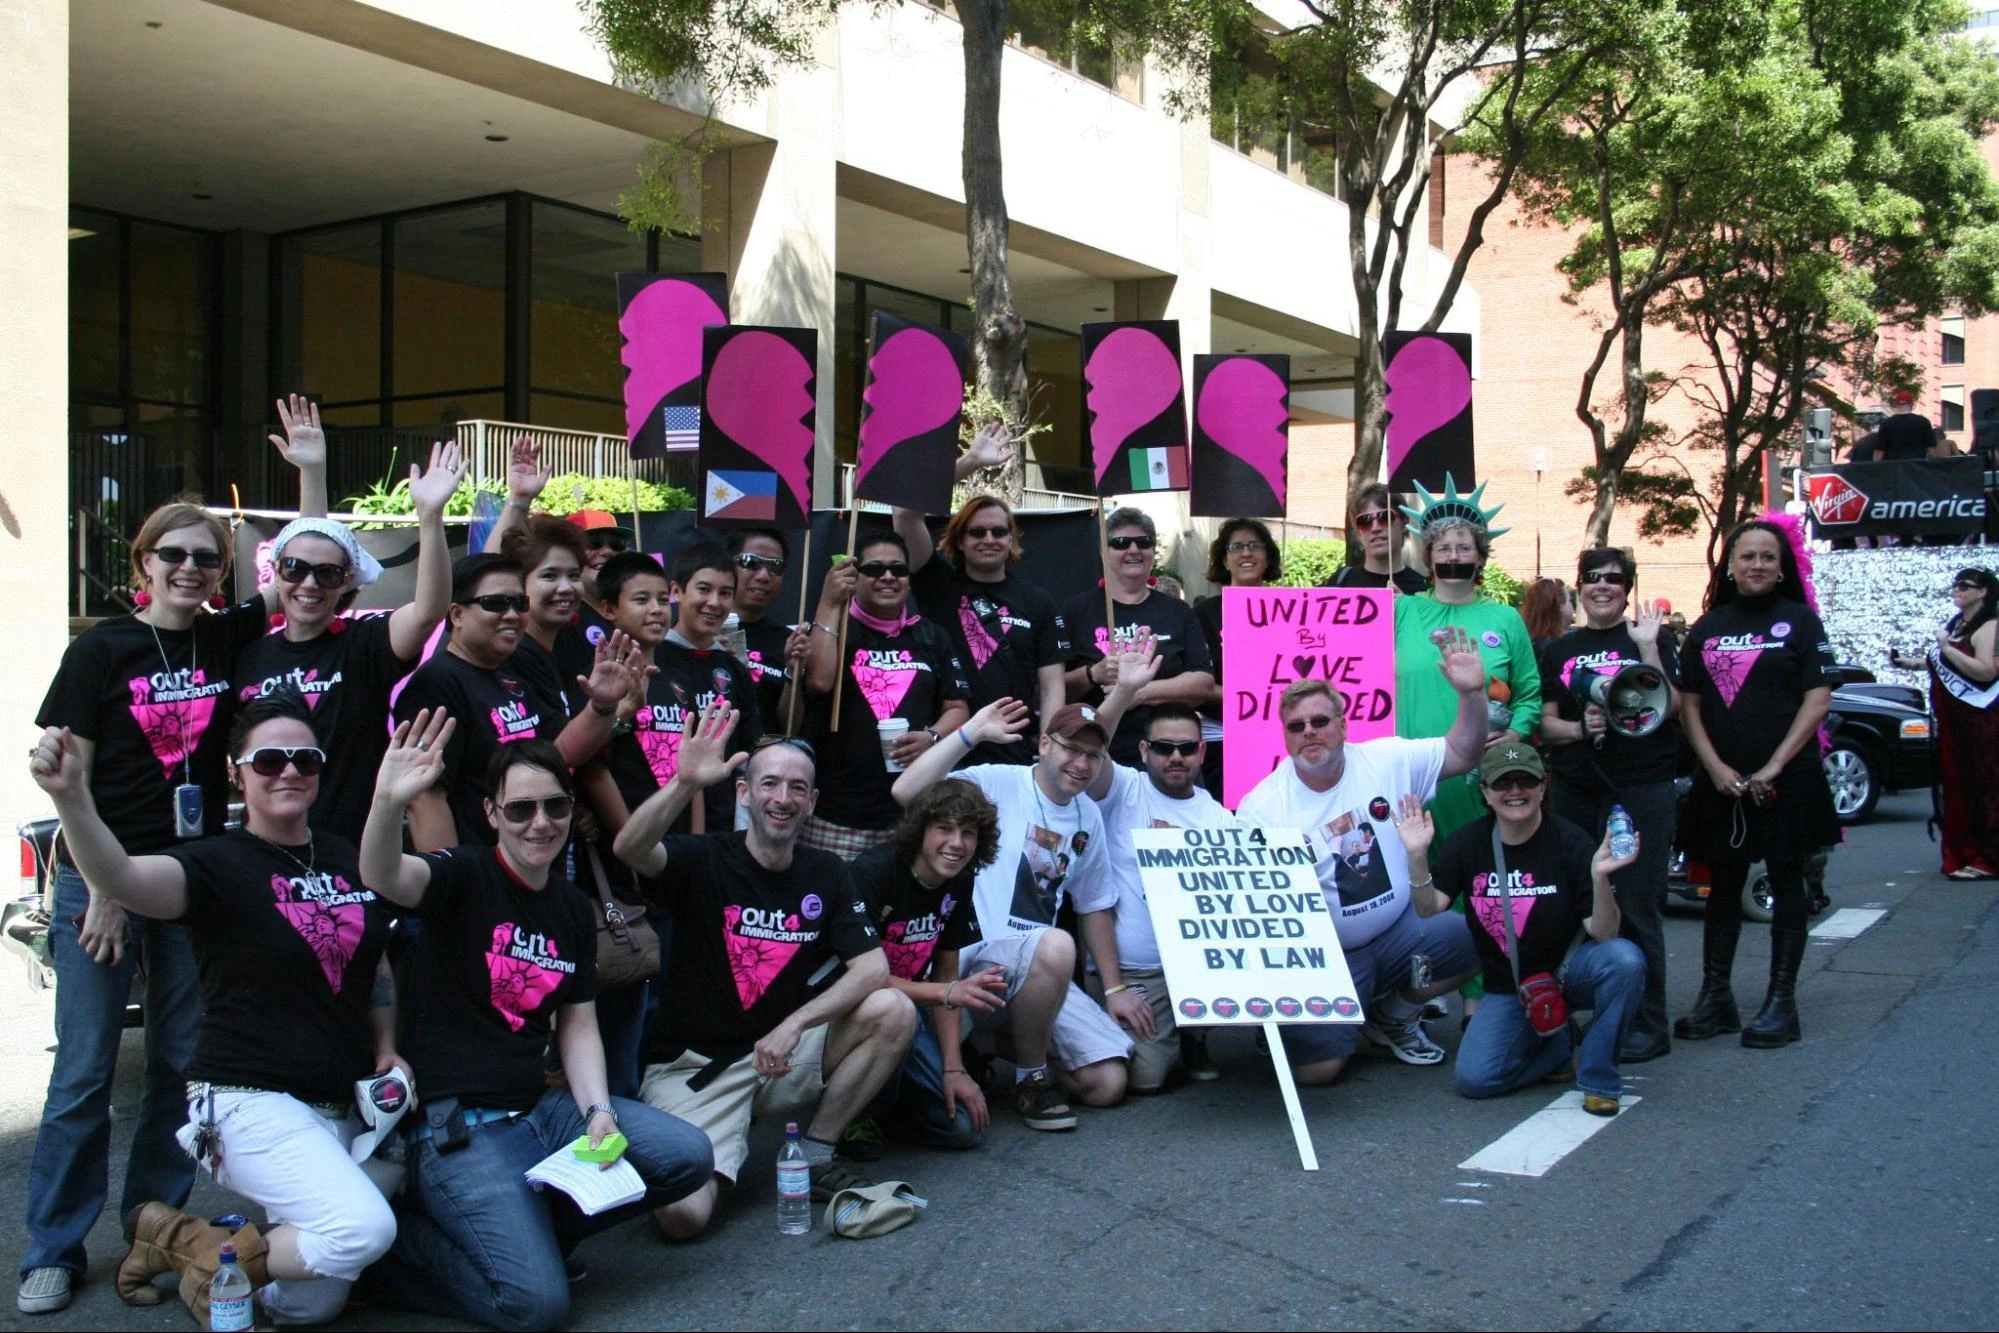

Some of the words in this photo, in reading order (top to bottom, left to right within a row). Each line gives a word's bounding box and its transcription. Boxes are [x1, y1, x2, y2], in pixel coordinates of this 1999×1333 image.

[1814, 482, 1858, 520] Virgin
[1870, 494, 1985, 519] america
[1184, 829, 1242, 846] OUT
[1249, 828, 1267, 846] 4
[1137, 843, 1317, 867] IMMIGRATION
[1178, 871, 1291, 891] UNITED
[1195, 894, 1234, 914] BY
[1245, 892, 1327, 914] LOVE
[1342, 905, 1368, 918] August
[1179, 918, 1305, 939] DIVIDED
[1204, 948, 1245, 969] BY
[1260, 947, 1326, 969] LAW
